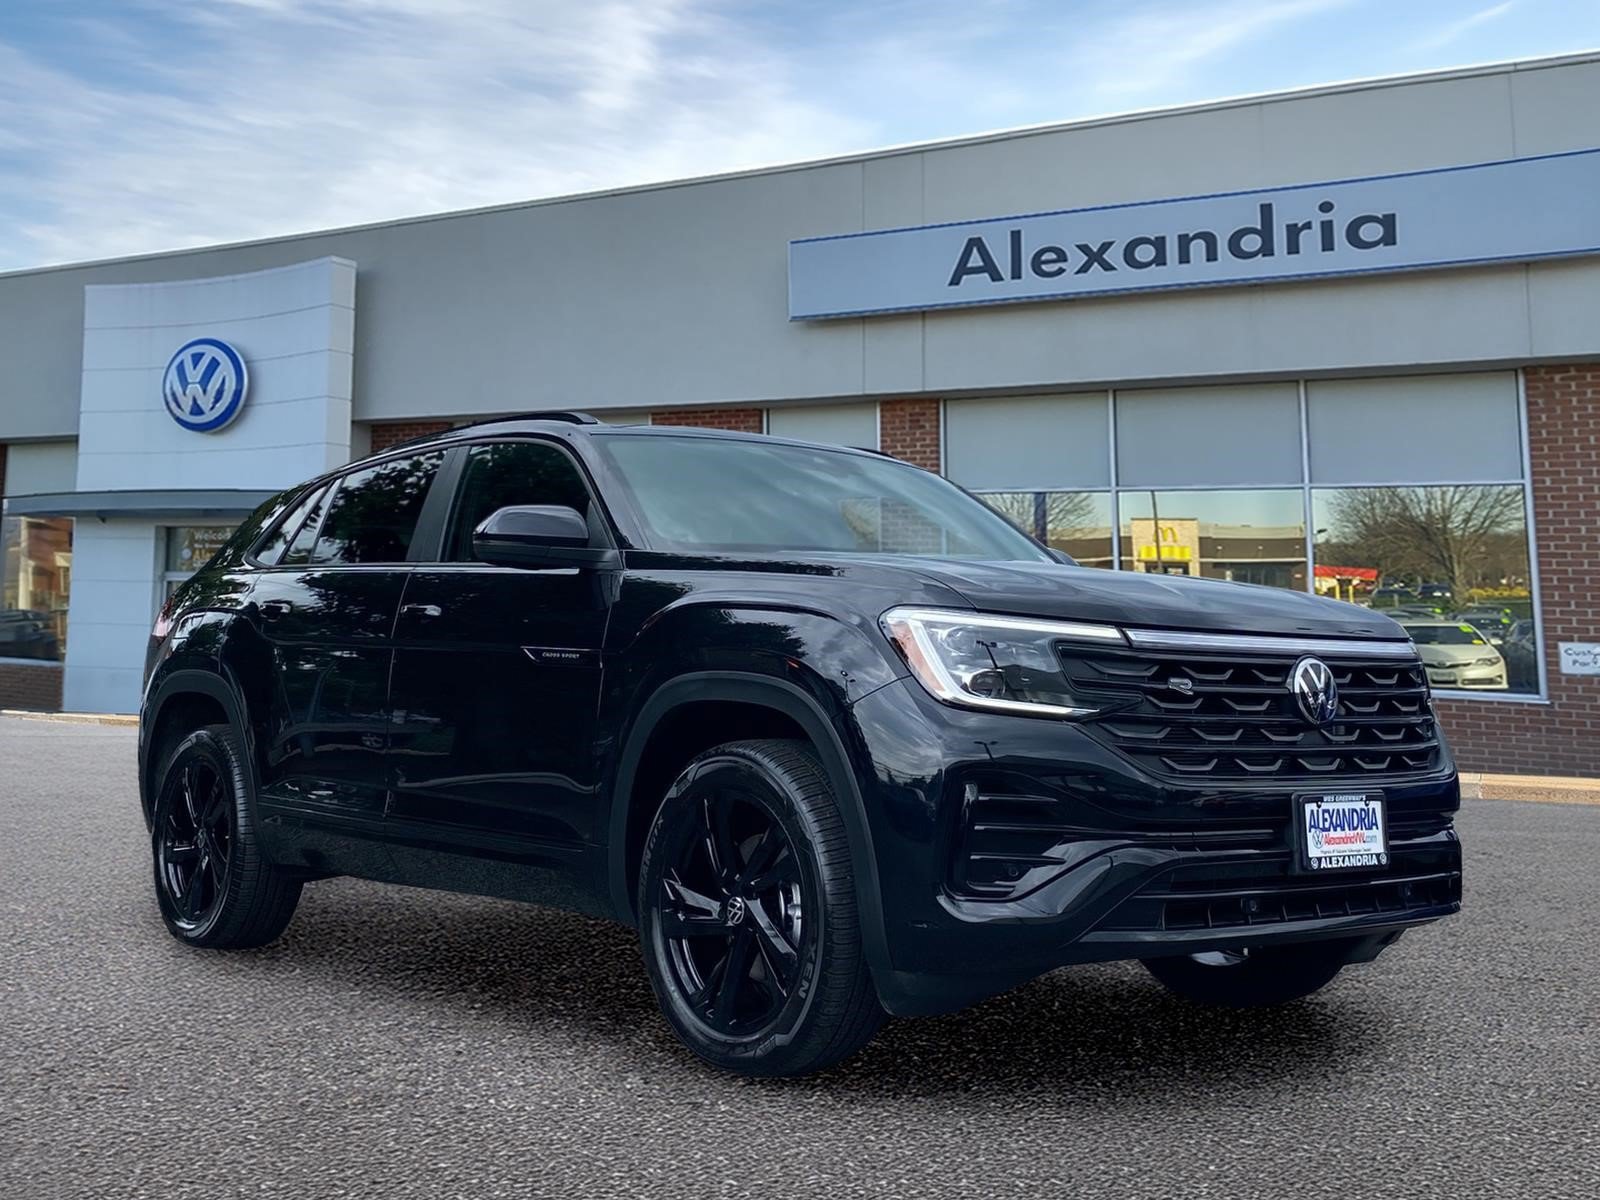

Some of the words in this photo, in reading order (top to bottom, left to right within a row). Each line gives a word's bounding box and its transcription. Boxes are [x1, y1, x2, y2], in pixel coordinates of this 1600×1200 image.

[947, 200, 1397, 287] Alexandria
[165, 341, 242, 428] VW
[1308, 807, 1379, 833] ALEXANDRIA
[1320, 854, 1379, 869] ALEXANDRIA
